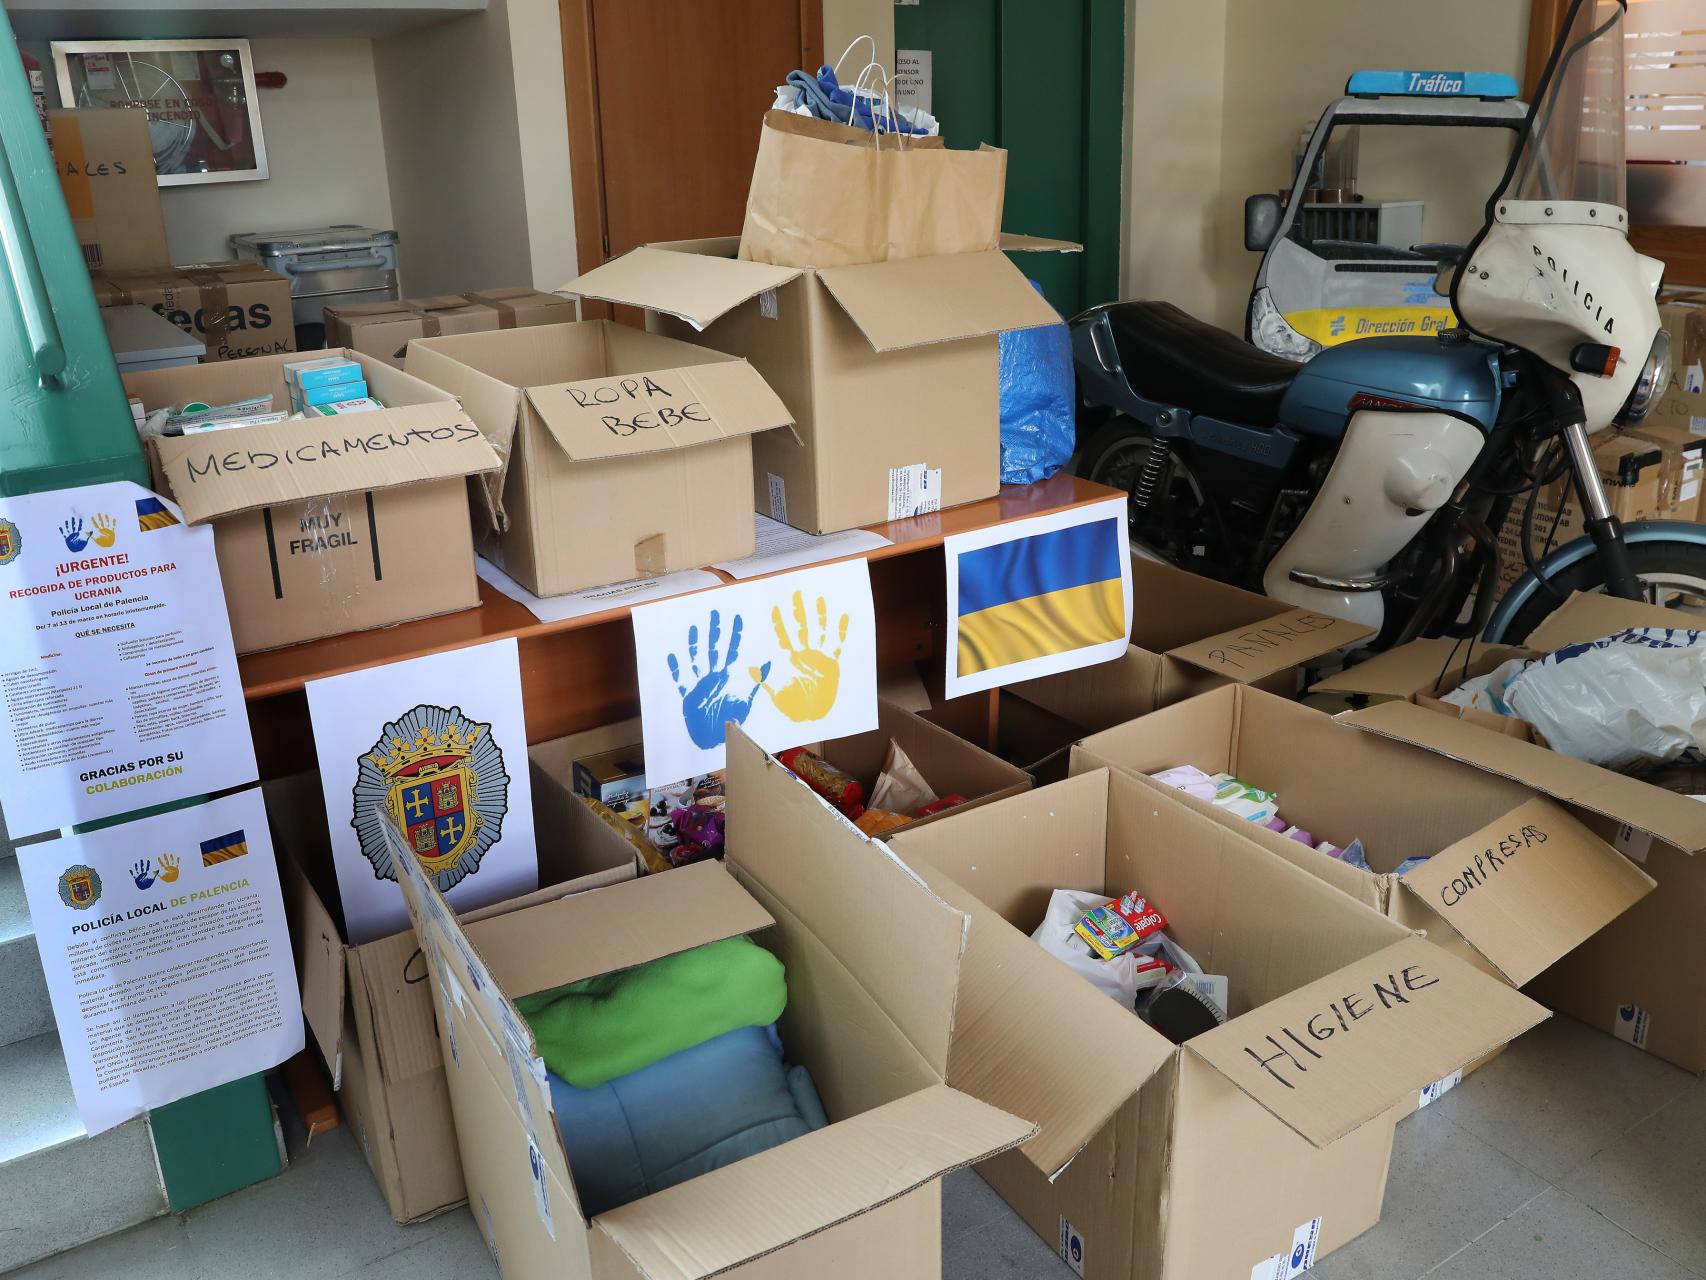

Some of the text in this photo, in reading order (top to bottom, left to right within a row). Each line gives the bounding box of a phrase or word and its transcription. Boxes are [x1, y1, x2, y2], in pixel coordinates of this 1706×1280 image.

[1408, 73, 1462, 92] Tráfico
[165, 98, 180, 108] EN
[1356, 318, 1416, 334] Dirección
[566, 376, 672, 408] ROPA
[602, 402, 711, 436] BEBE
[186, 423, 480, 483] MEDICAMENTOS
[299, 511, 342, 532] MUY
[290, 533, 358, 555] FRAGIL
[56, 553, 129, 577] ¡URGENTE!
[9, 562, 177, 599] RECOGIDA DE PRODUCTOS PARA
[74, 586, 122, 600] UCRANIA
[51, 594, 149, 618] Policía Local de Palencia
[91, 626, 102, 636] SE
[102, 622, 136, 634] NECESITA
[80, 750, 184, 782] GRACIAS POR SU
[86, 765, 183, 795] COLABORACIÓN
[72, 878, 249, 935] POLICÍA LOCAL DE PALENCIA
[1134, 914, 1162, 932] Colgate
[1244, 965, 1440, 1089] HIGIENE
